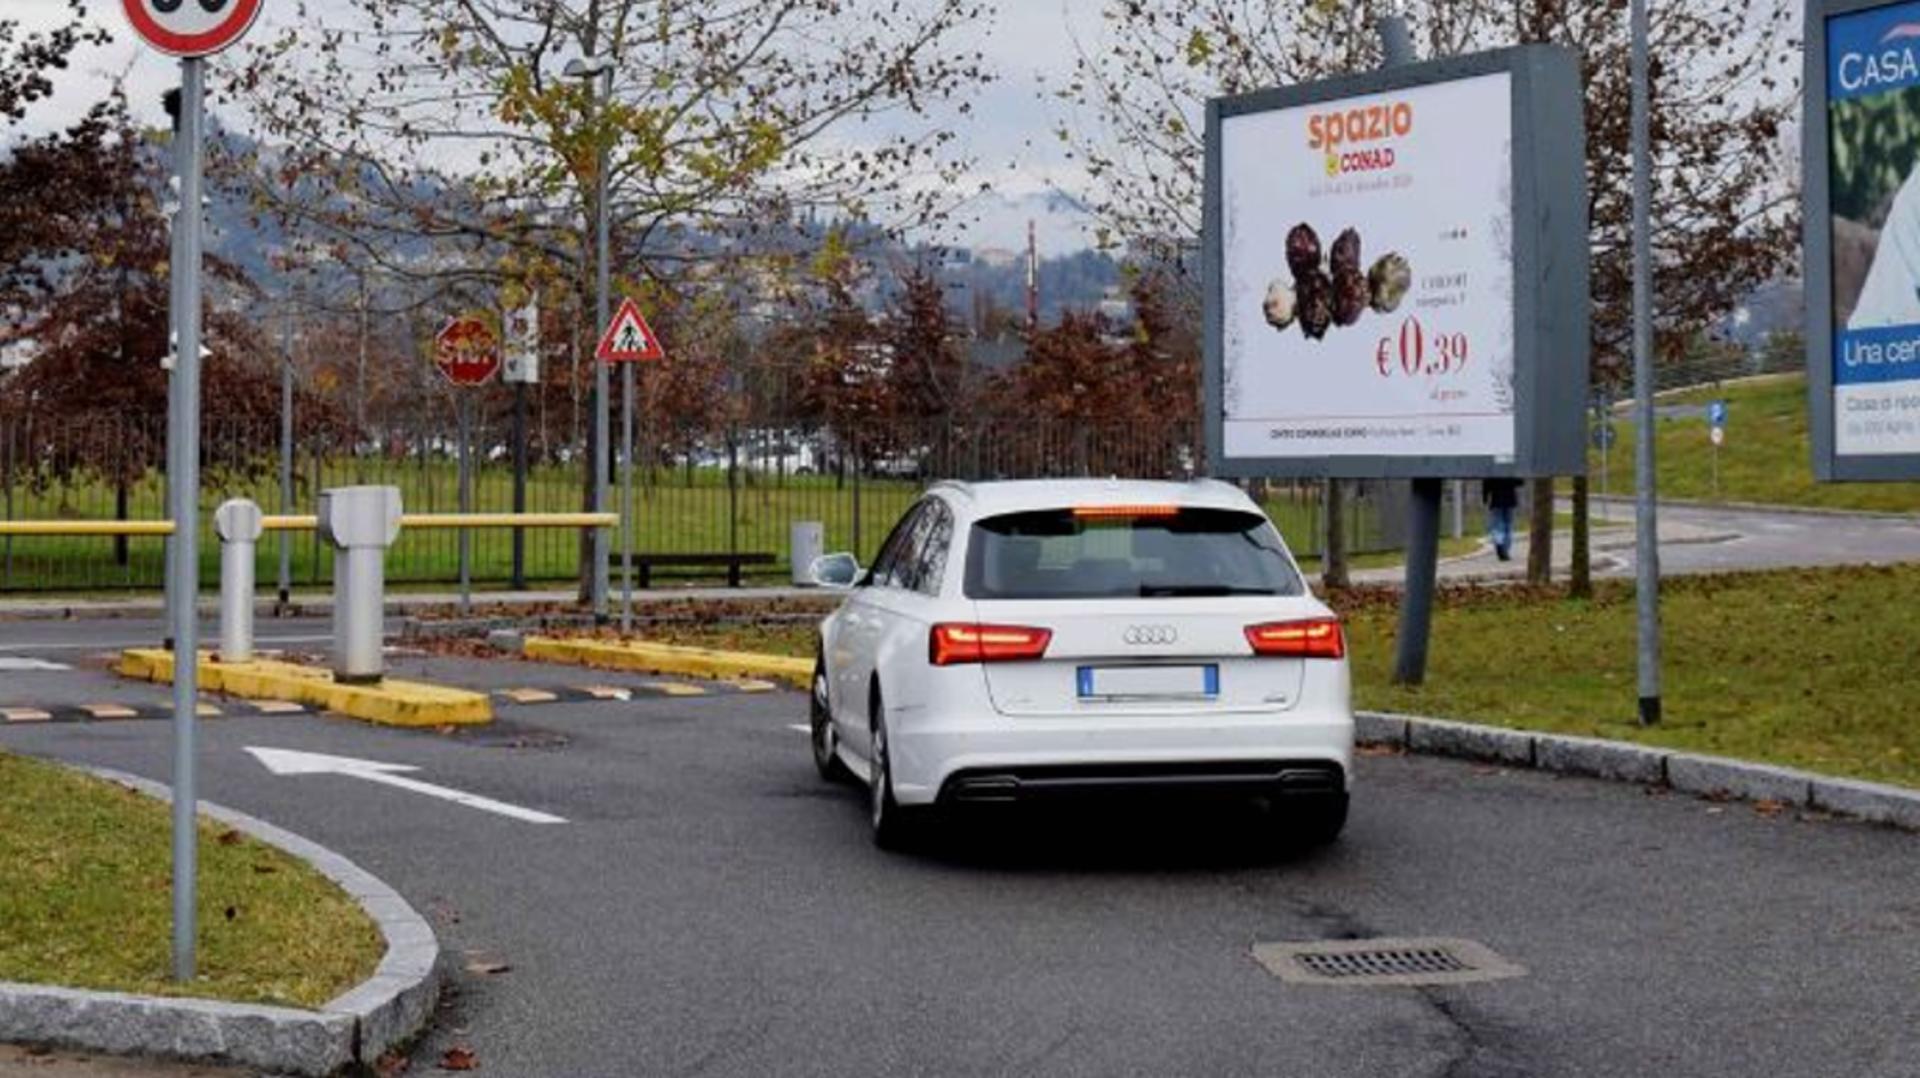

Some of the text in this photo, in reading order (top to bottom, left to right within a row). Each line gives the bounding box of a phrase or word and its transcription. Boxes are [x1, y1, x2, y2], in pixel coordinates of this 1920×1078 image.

[1839, 47, 1918, 90] CASA
[1308, 102, 1412, 153] spazio
[1340, 148, 1395, 172] CONAD
[1844, 335, 1920, 367] Una cer
